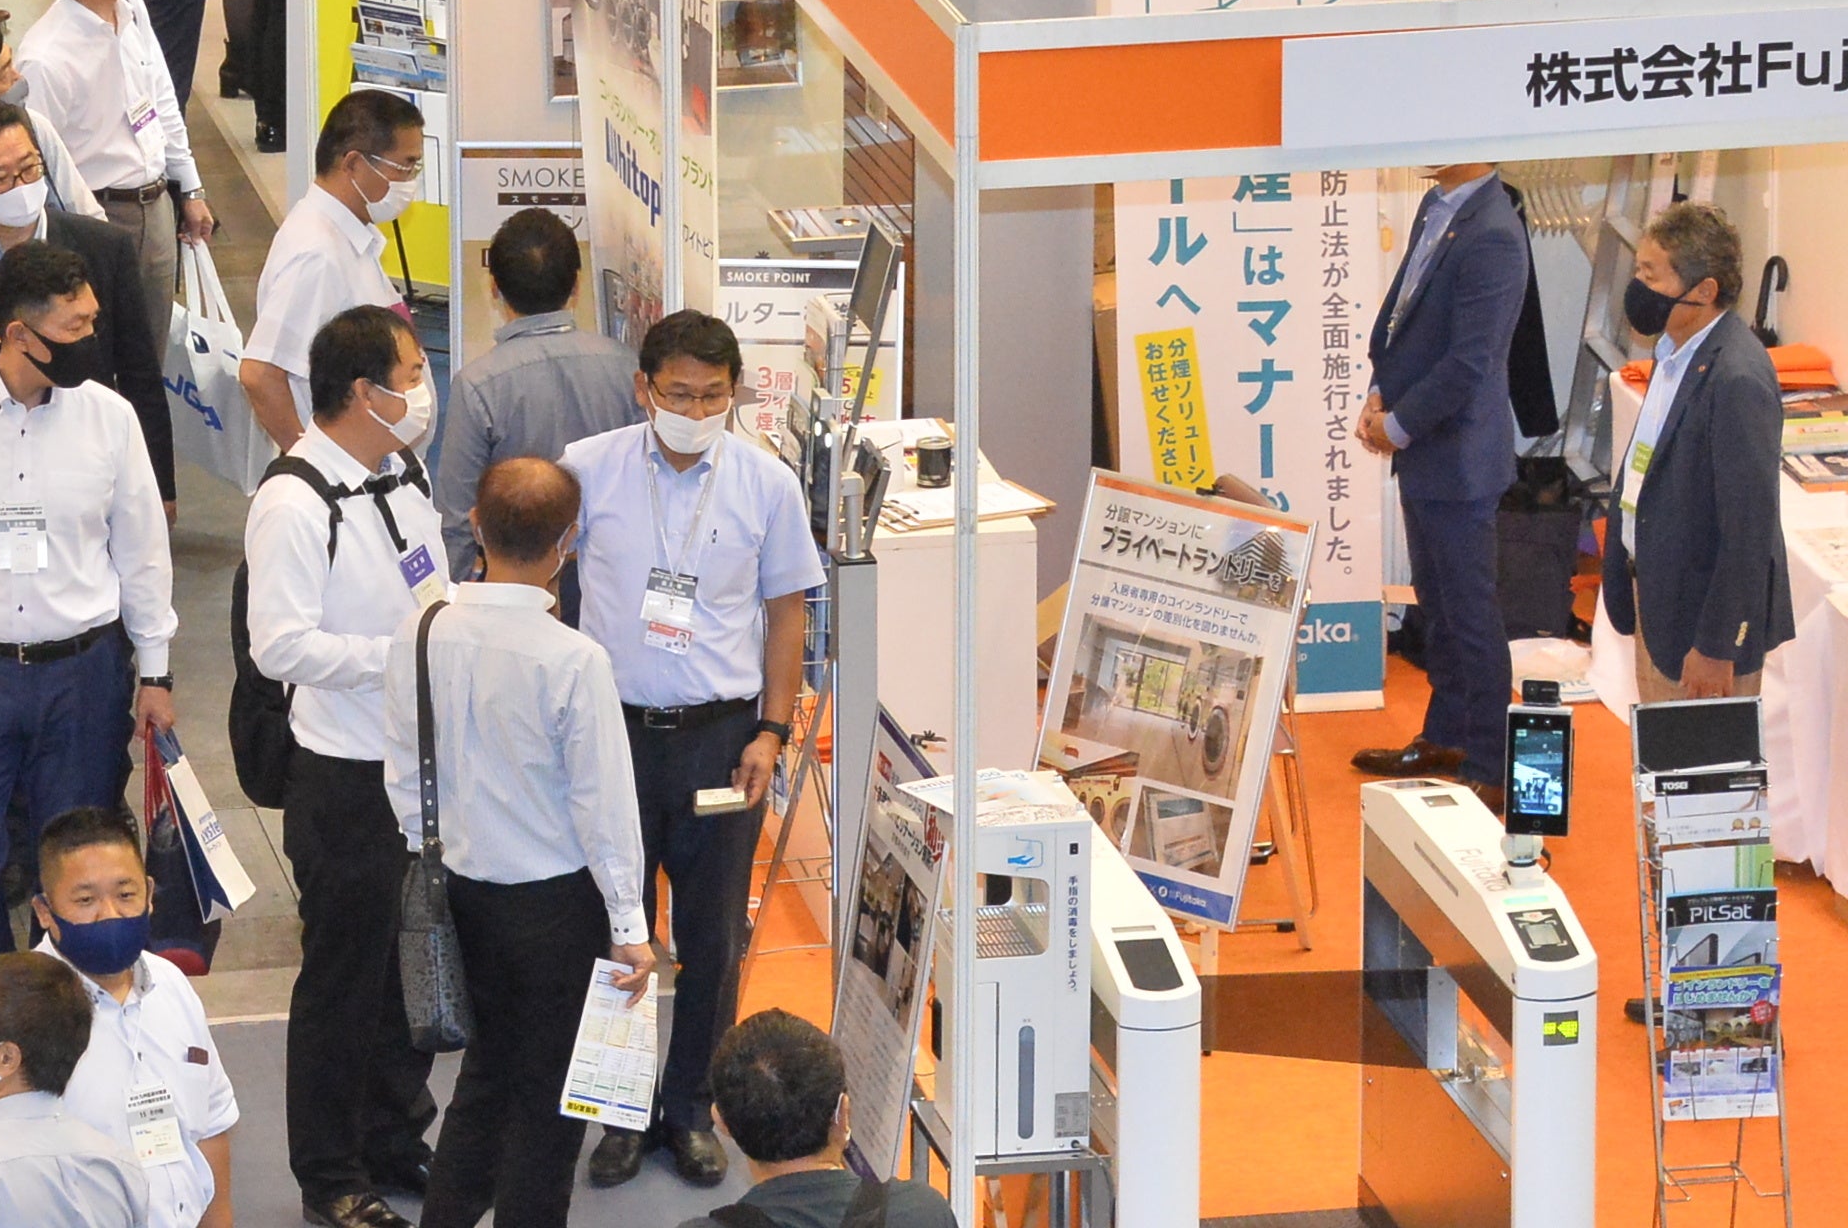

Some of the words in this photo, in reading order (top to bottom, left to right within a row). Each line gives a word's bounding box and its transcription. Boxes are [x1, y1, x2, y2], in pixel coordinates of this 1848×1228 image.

[497, 167, 586, 188] SMOKE
[726, 272, 770, 283] SMOKE
[773, 272, 811, 283] POINT
[1320, 170, 1353, 575] 防止法が全面施行されました。
[1144, 341, 1184, 486] お任せください
[1104, 503, 1204, 540] 分譲マンションに
[1100, 524, 1281, 593] プライベートランドリーを
[1660, 780, 1689, 791] TOSEI
[1689, 904, 1752, 923] PitSat
[1067, 875, 1079, 992] 手指の消毒をしましょう。
